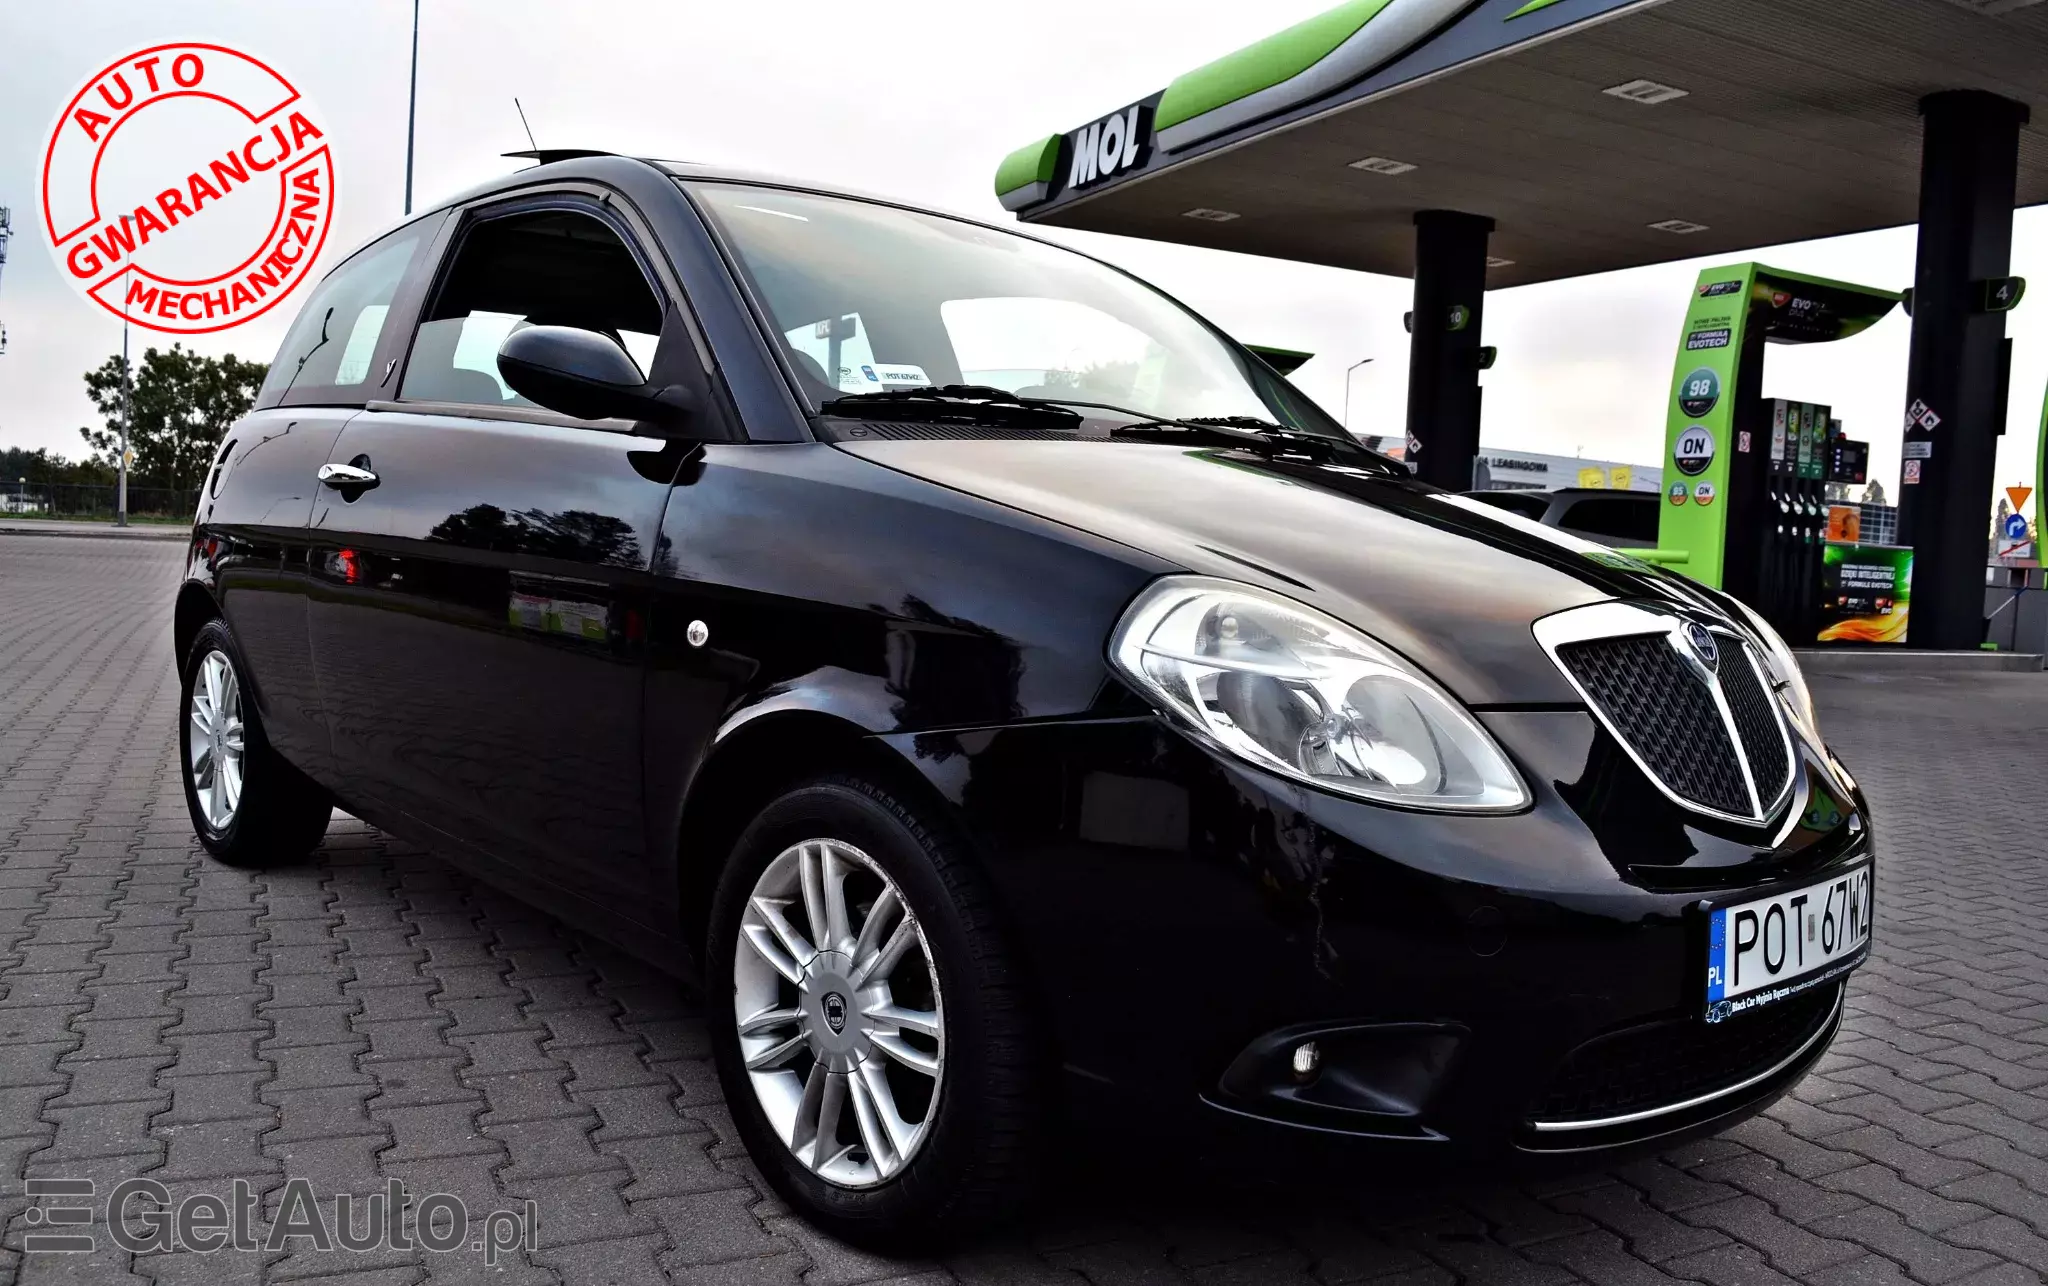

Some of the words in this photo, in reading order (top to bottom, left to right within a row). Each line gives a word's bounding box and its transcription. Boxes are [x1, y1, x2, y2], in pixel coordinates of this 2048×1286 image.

[1068, 105, 1139, 188] MOL
[1996, 285, 2008, 300] 4
[1791, 298, 1811, 310] EVO
[1450, 312, 1461, 323] 10
[1696, 330, 1728, 340] FORMULA
[1687, 338, 1727, 350] EVOTECH
[1479, 353, 1485, 363] 2
[1689, 379, 1710, 396] 98
[1683, 438, 1705, 454] ON
[1492, 457, 1548, 472] LEASINGOWA
[1698, 486, 1710, 495] ON
[1734, 894, 1808, 986] POT
[1821, 871, 1869, 955] 67W2
[1708, 966, 1723, 987] PL
[1732, 998, 1746, 1012] Black
[1746, 997, 1755, 1008] Car
